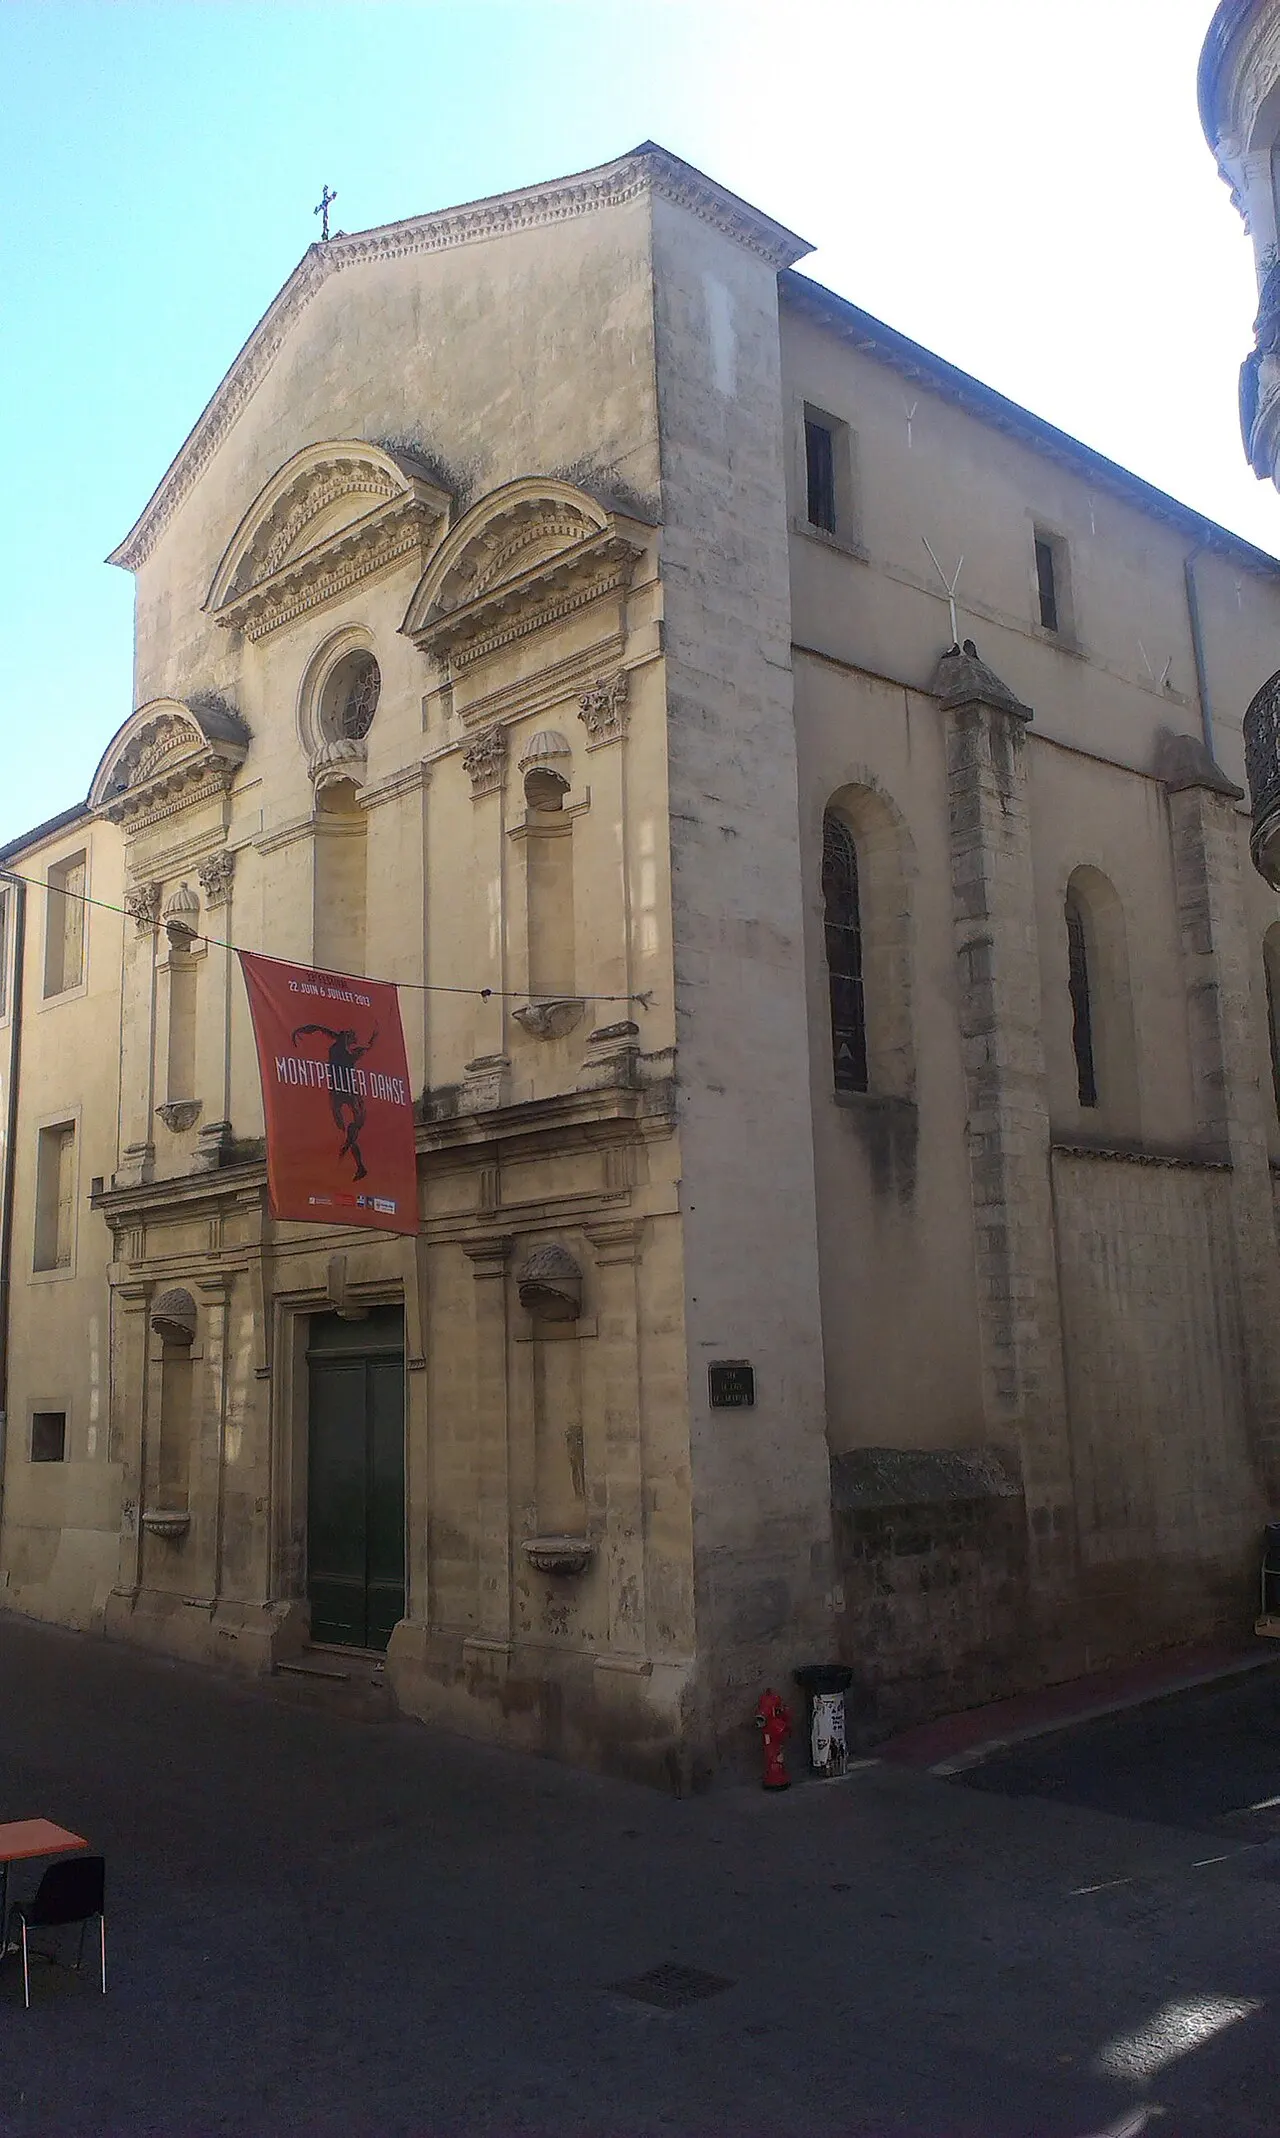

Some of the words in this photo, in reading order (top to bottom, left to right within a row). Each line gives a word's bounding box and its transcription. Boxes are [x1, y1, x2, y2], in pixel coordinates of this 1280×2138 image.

[288, 980, 299, 992] 22
[300, 983, 319, 995] JUIN
[320, 986, 326, 997] 6
[327, 988, 354, 1002] JUILLET
[354, 993, 371, 1007] 2013
[275, 1056, 367, 1096] MONTPELLIER
[370, 1072, 406, 1106] DANSE
